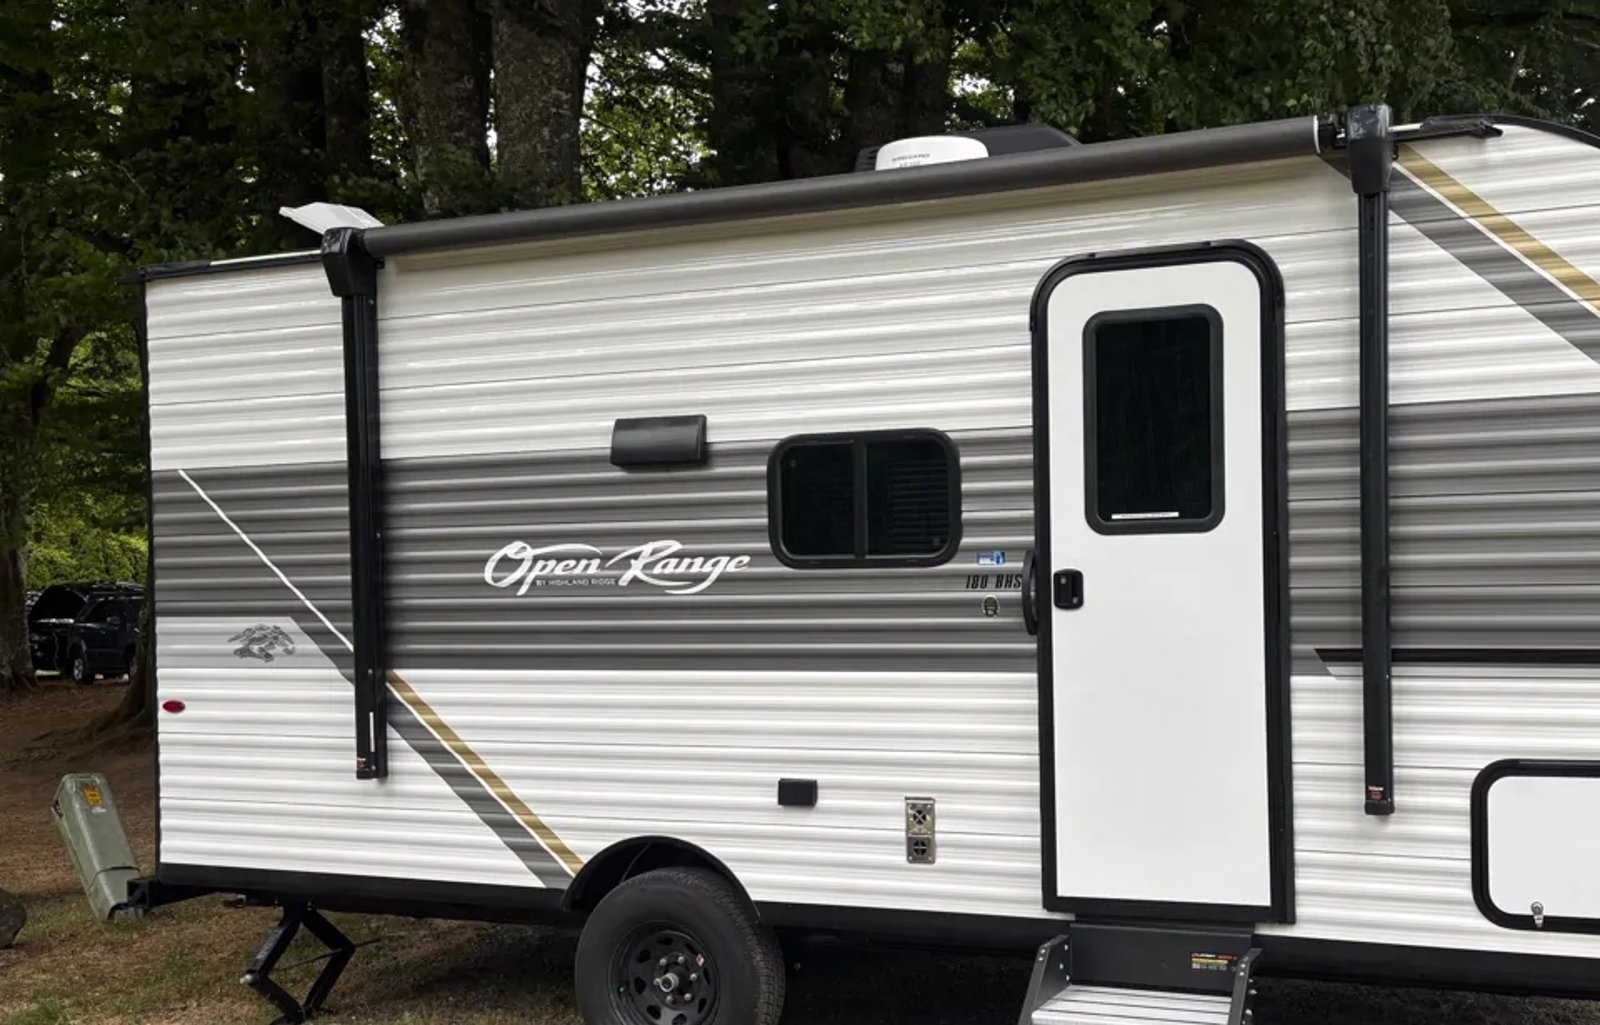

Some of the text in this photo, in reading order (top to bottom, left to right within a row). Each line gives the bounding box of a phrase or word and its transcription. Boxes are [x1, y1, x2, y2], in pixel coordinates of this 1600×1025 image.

[484, 539, 751, 596] Open Range
[966, 573, 1023, 590] 180 BHS
